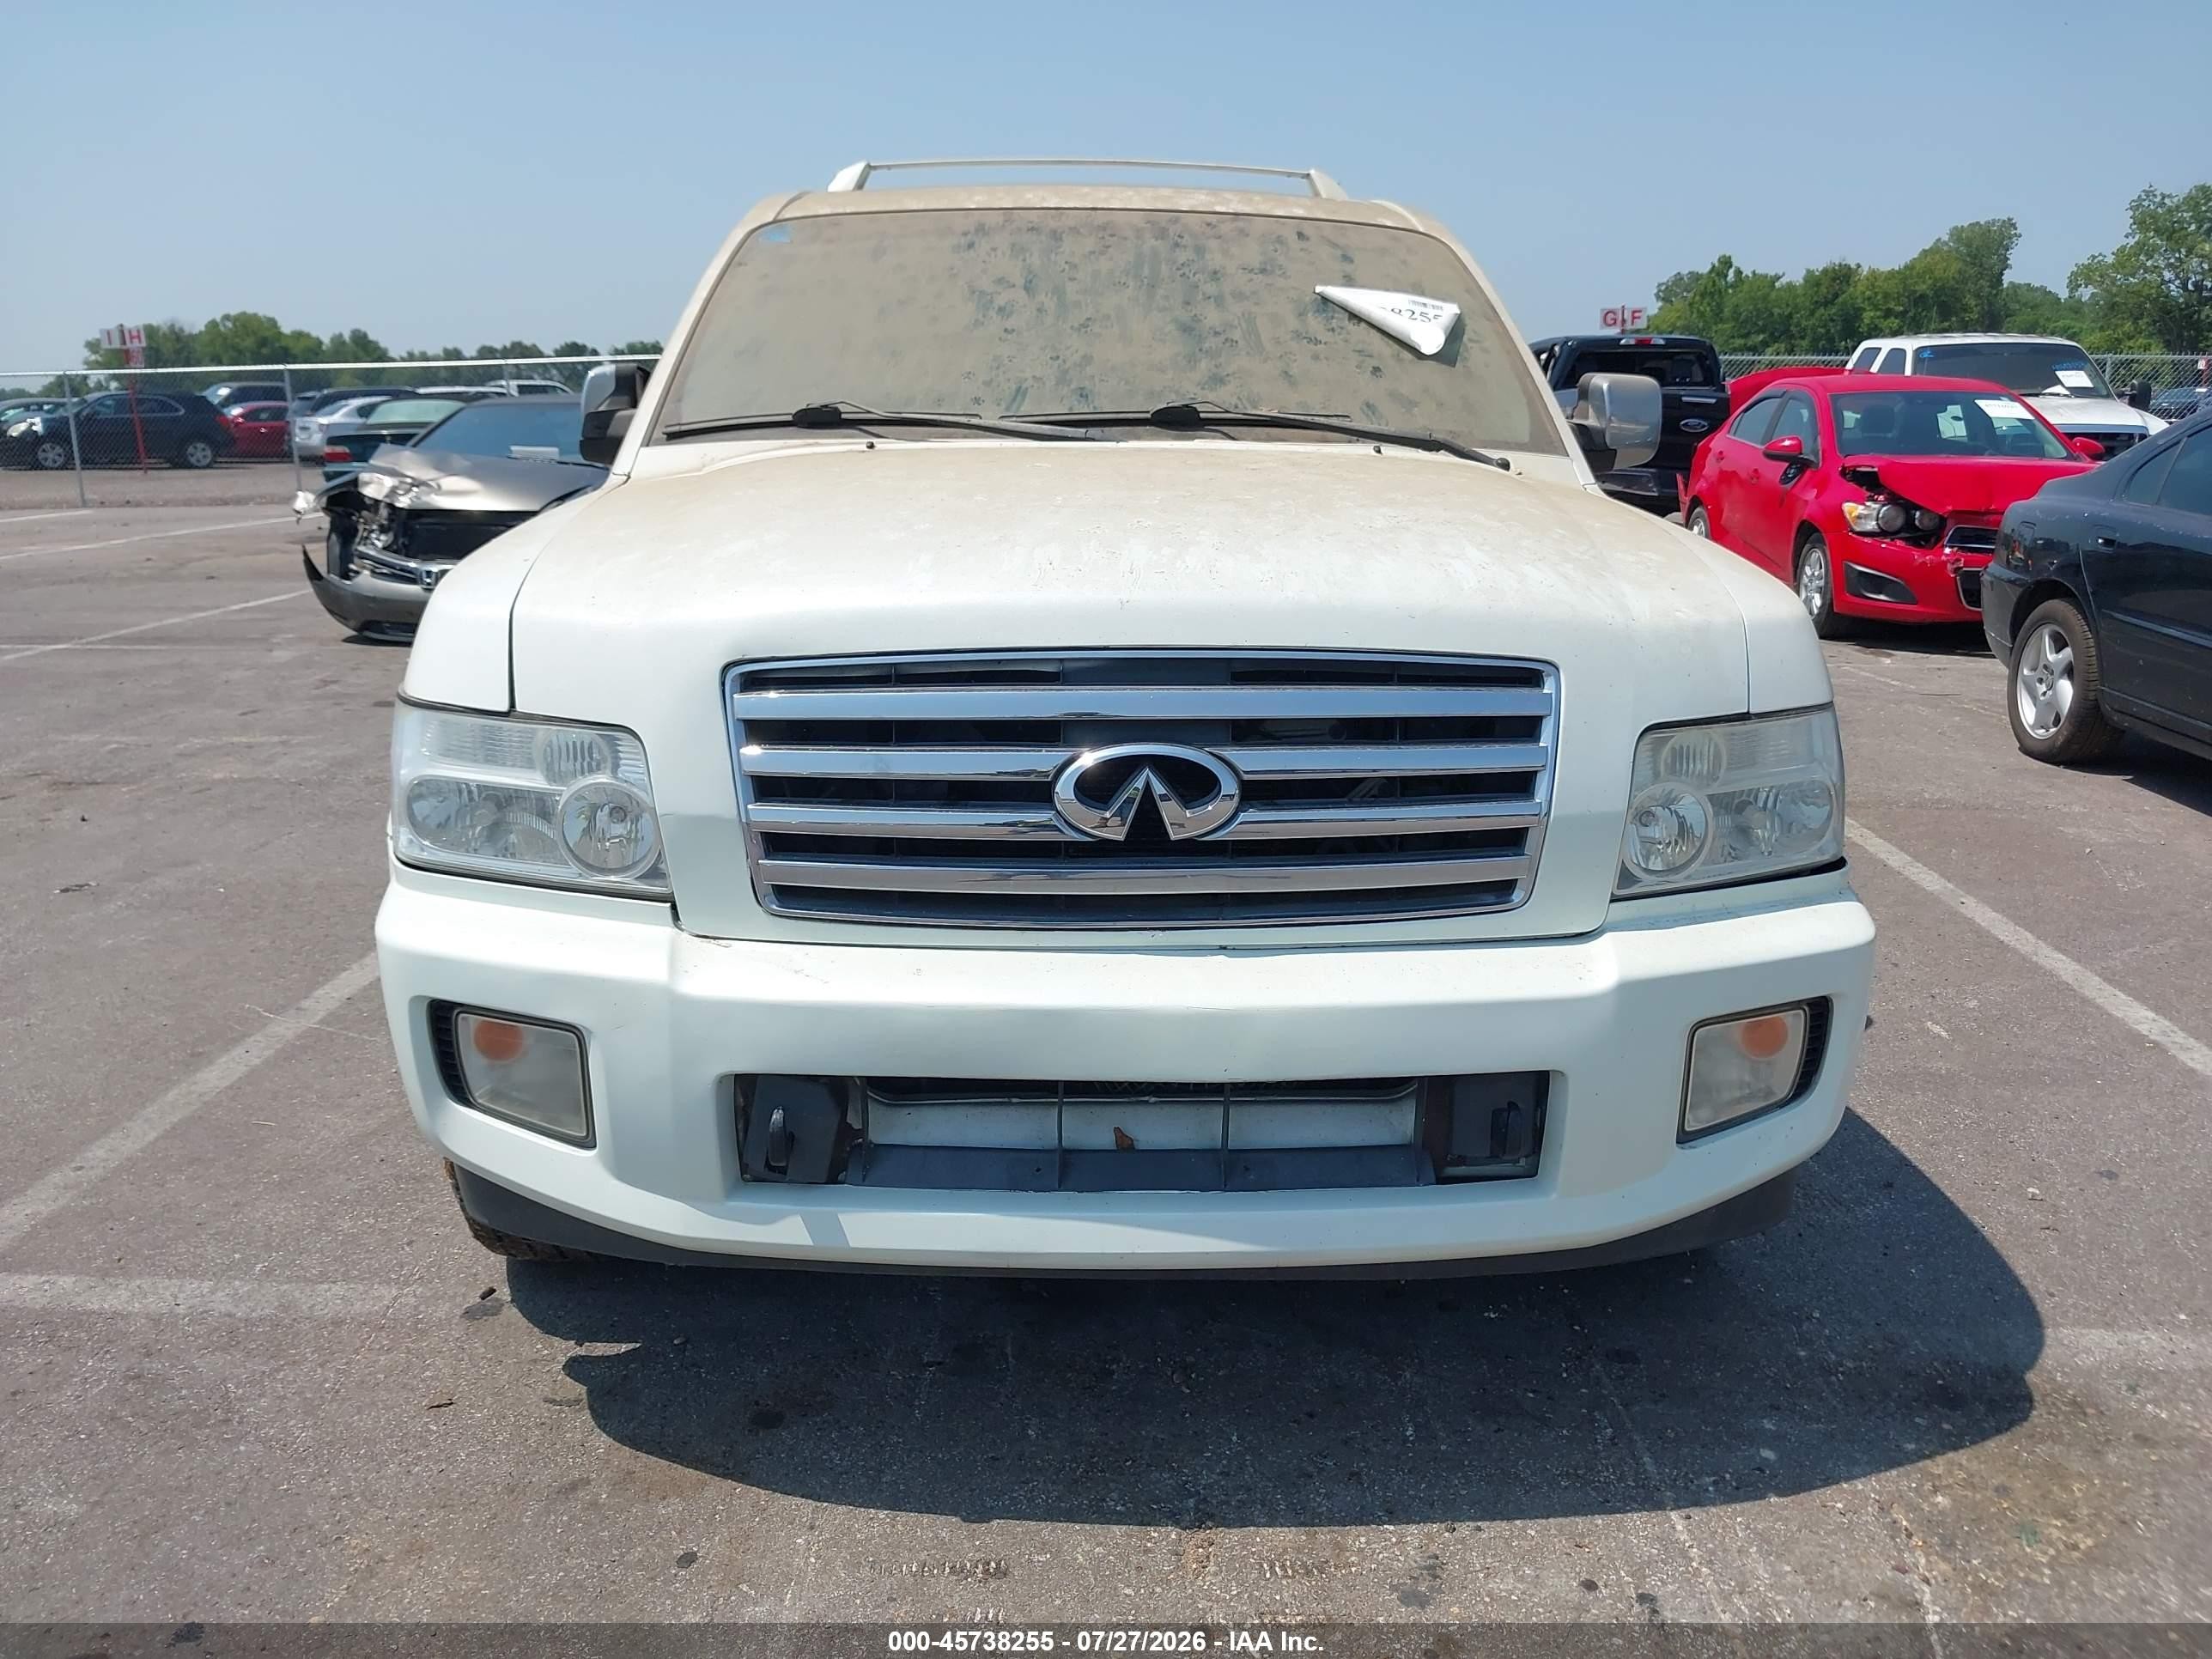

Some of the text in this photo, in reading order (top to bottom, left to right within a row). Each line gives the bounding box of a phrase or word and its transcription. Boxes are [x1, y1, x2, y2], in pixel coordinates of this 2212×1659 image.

[1602, 310, 1642, 326] G F
[128, 329, 142, 344] H
